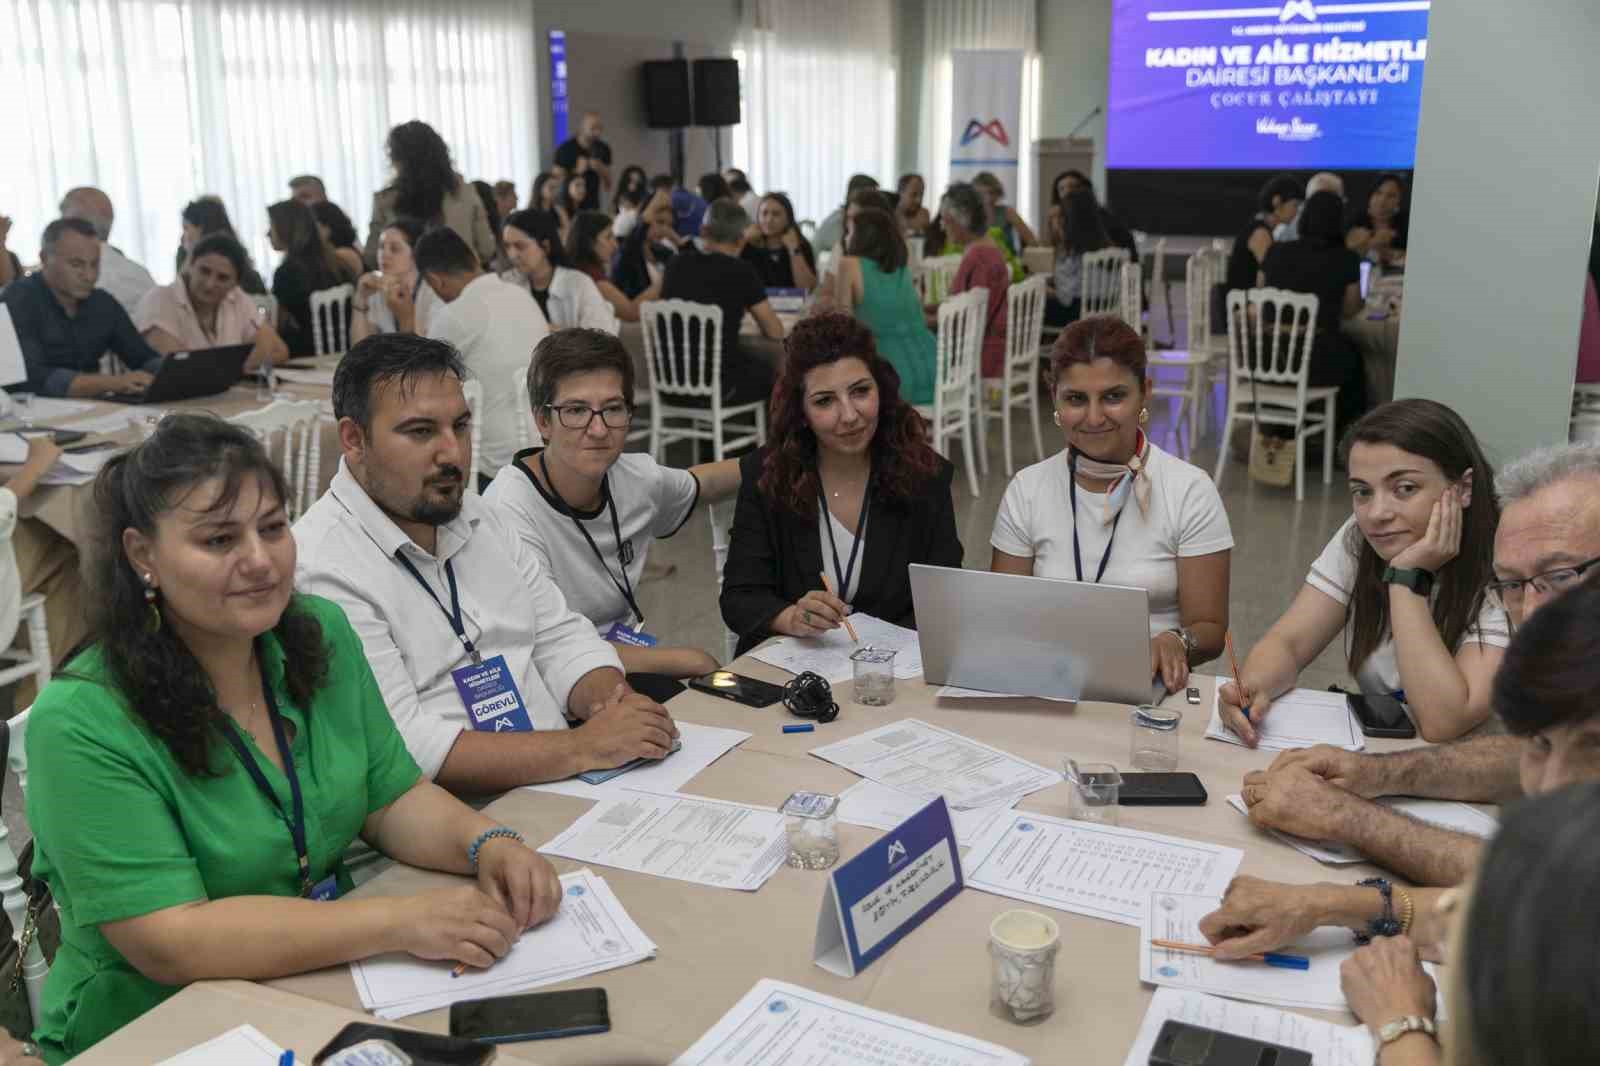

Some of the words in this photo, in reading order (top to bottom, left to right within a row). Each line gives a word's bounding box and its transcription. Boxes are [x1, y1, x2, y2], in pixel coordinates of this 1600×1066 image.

[1145, 47, 1217, 68] KADIN
[1220, 45, 1253, 65] VE
[1254, 38, 1309, 65] AİLE
[1185, 64, 1270, 88] DAİRESİ
[1274, 61, 1409, 89] BAŞKANLIĞI
[1210, 91, 1272, 109] ÇOCUK
[475, 693, 516, 716] GÖREVLİ
